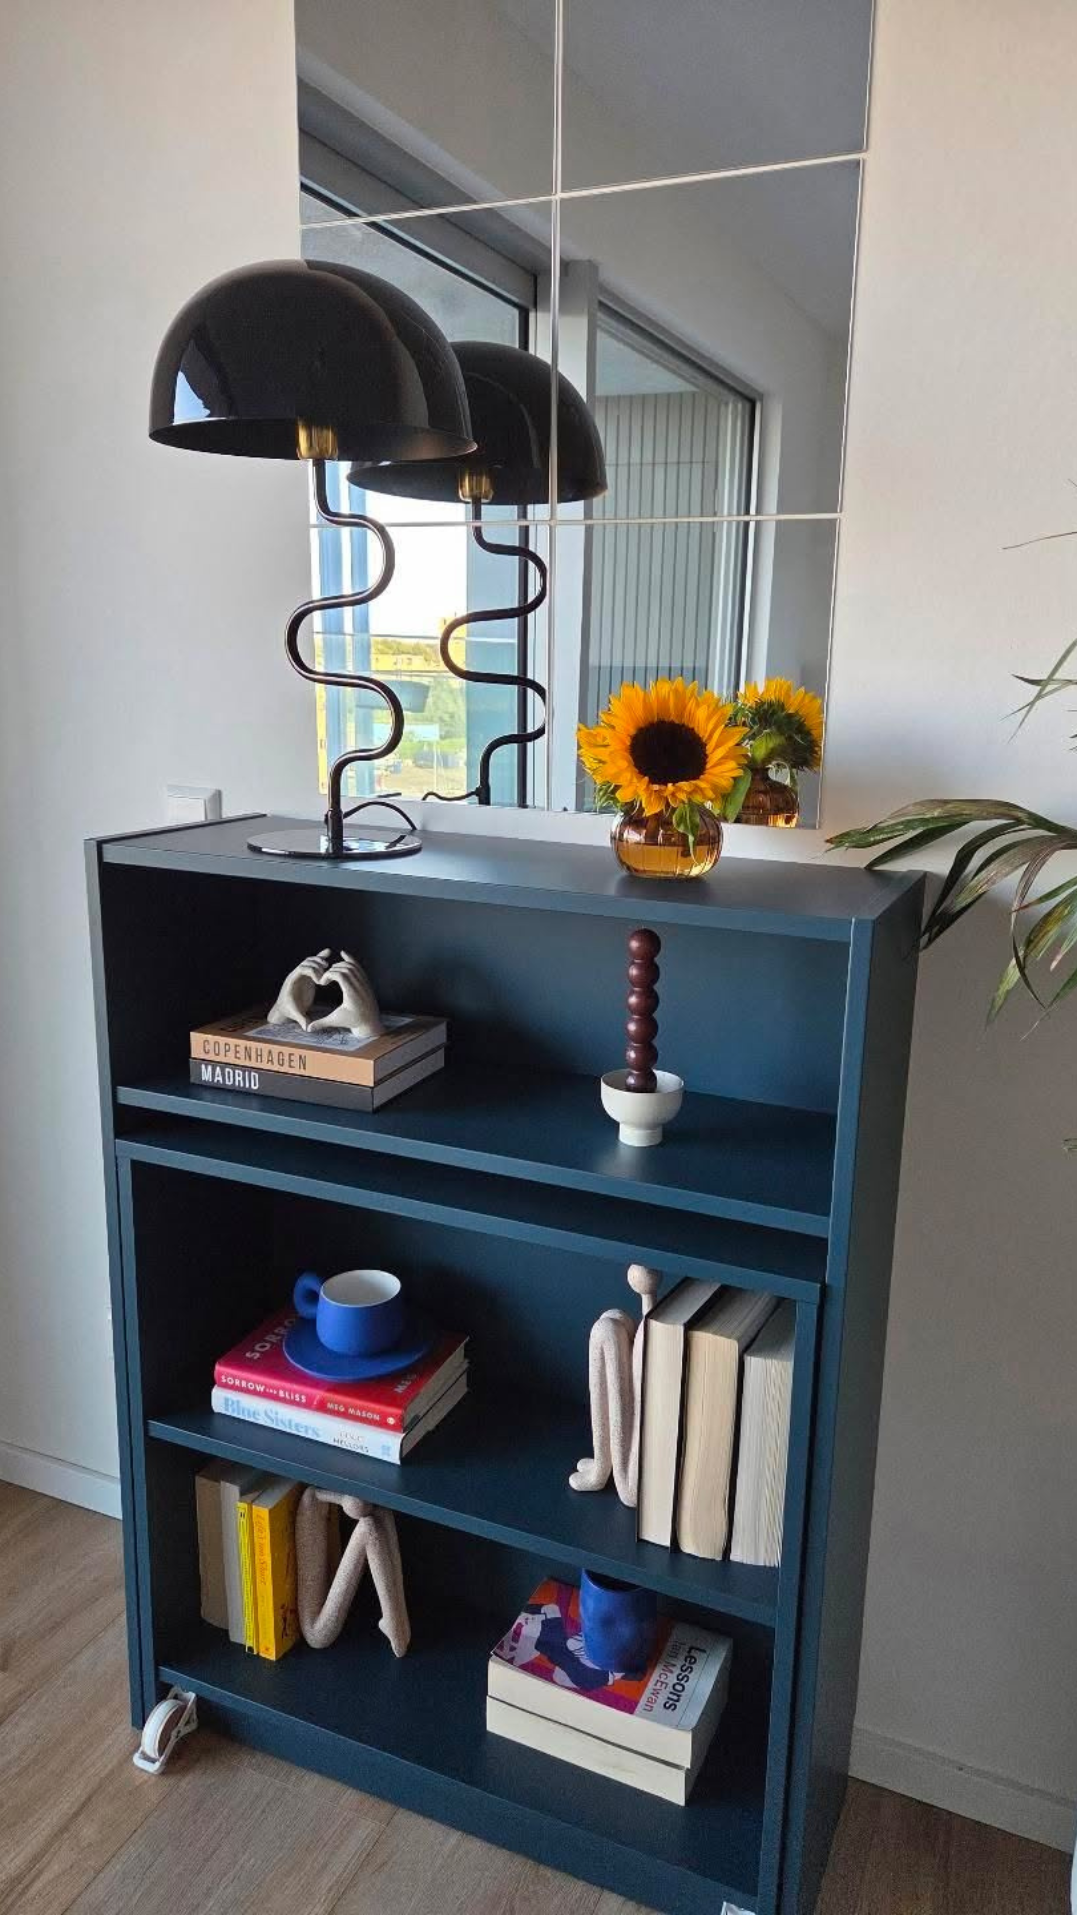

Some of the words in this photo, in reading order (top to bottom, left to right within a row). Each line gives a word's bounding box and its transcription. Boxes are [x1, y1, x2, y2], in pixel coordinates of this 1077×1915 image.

[203, 1039, 307, 1071] COPENHAGEN
[201, 1064, 259, 1089] MADRID
[245, 1318, 295, 1360] SORRO
[221, 1375, 265, 1392] SORROW
[222, 1396, 261, 1422] Blue
[263, 1407, 322, 1439] Sisters
[327, 1402, 345, 1413] MEG
[347, 1407, 380, 1422] MASON
[667, 1642, 686, 1659] Ian
[643, 1662, 676, 1713] McEwan
[664, 1647, 707, 1711] Lessons
